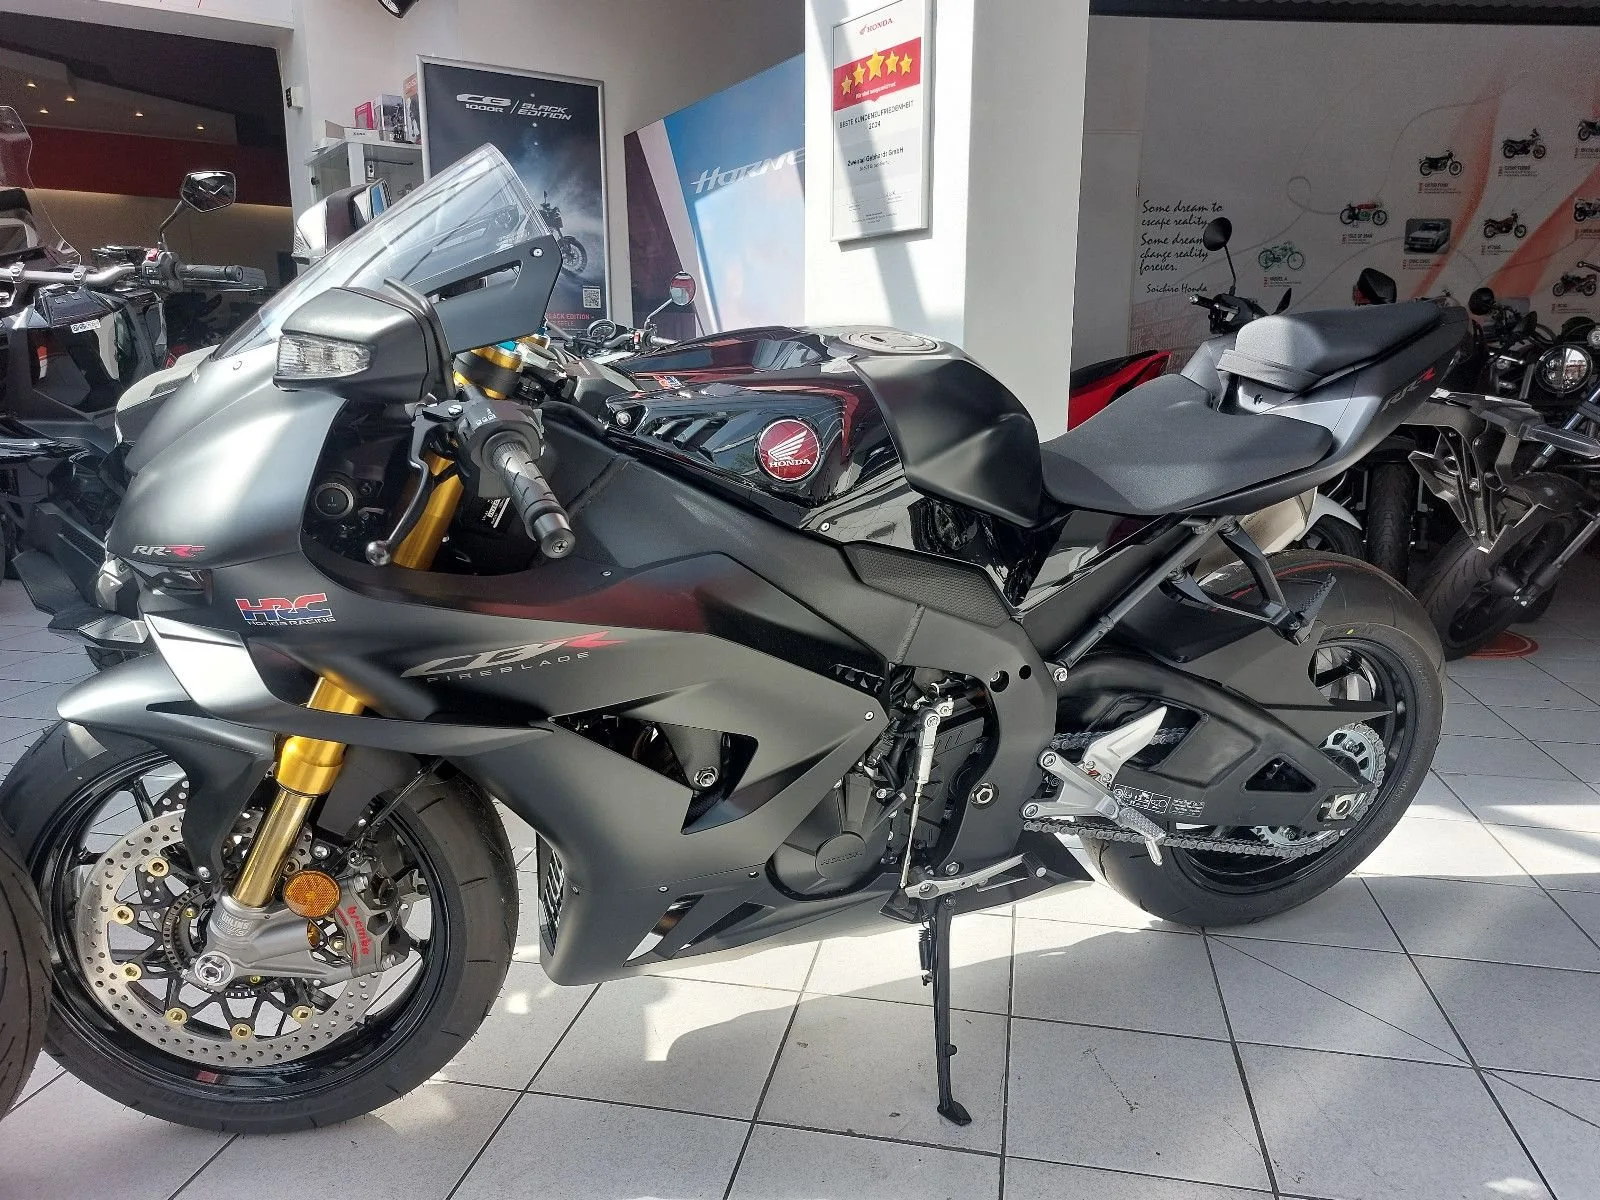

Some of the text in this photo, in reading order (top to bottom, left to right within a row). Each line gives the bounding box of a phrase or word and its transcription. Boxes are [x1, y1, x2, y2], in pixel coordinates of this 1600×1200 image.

[867, 17, 893, 33] HONDA
[456, 93, 512, 107] CB
[465, 103, 504, 113] 1000R
[517, 108, 572, 121] EDITION
[521, 102, 568, 114] BLACK
[839, 117, 854, 129] BESTE
[1142, 200, 1224, 214] Some dream to
[1141, 217, 1171, 230] escape
[1140, 233, 1169, 247] Some
[1140, 247, 1209, 262] change reality
[1139, 260, 1178, 275] forever.
[1146, 283, 1208, 294] Soichiro Honda
[768, 458, 812, 468] HONDA
[235, 593, 333, 622] HRC
[289, 616, 336, 626] RACING
[426, 651, 590, 684] FIREBLADE
[346, 904, 372, 955] brembo
